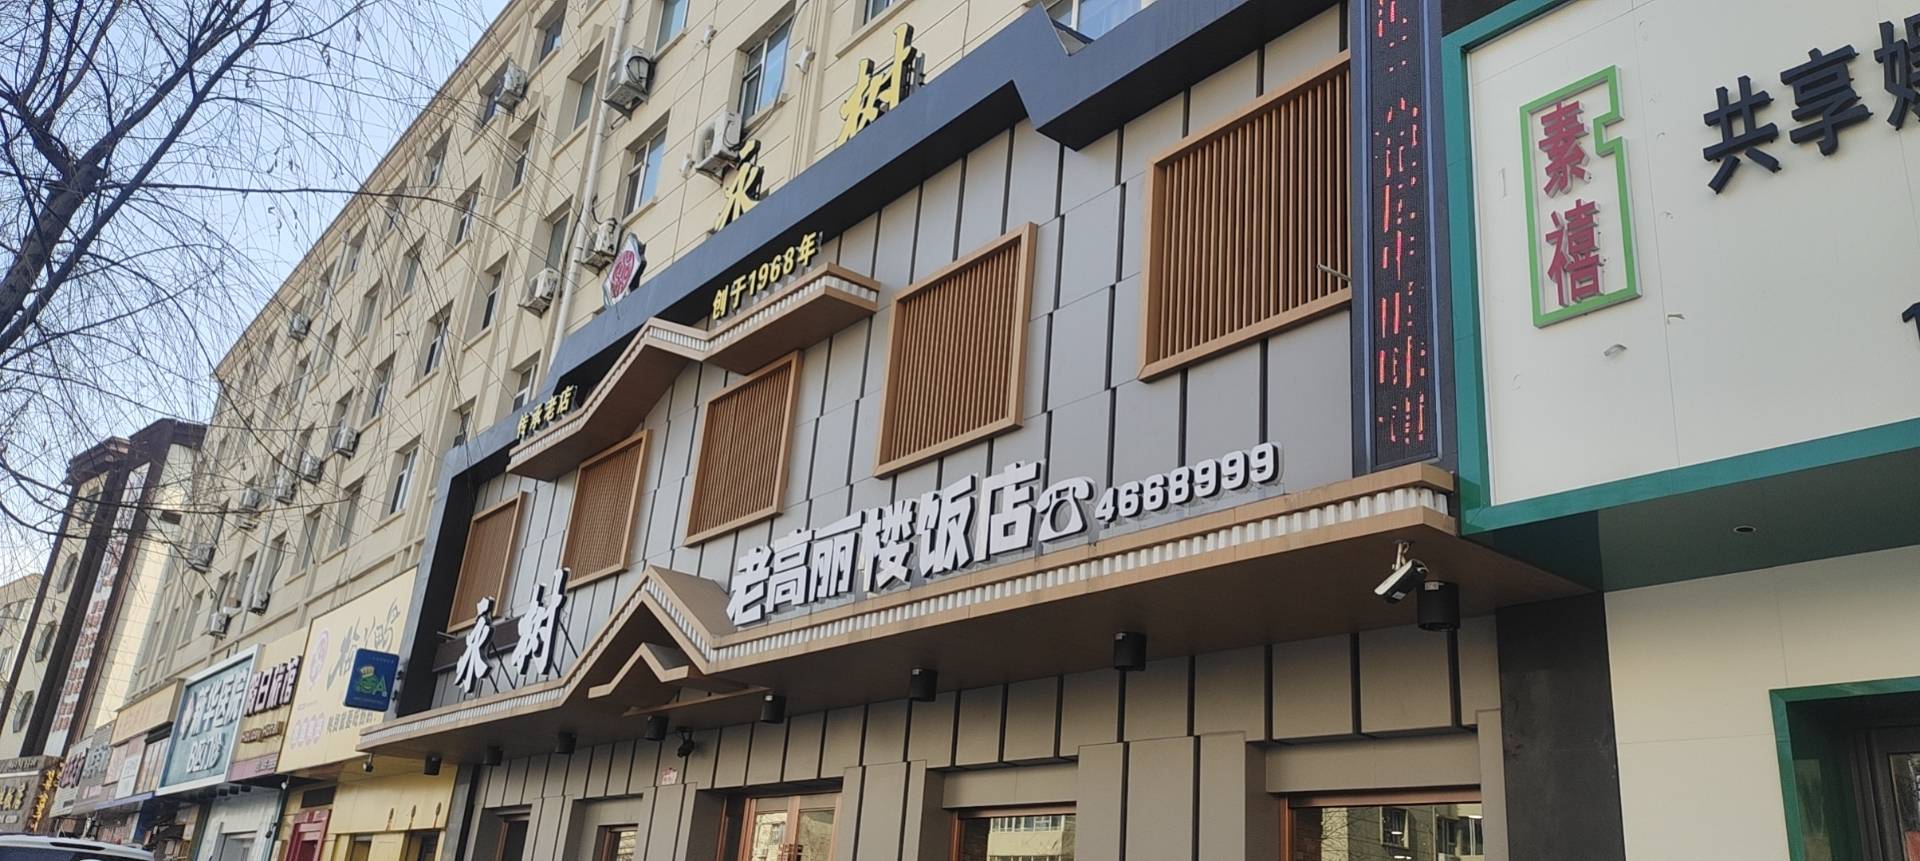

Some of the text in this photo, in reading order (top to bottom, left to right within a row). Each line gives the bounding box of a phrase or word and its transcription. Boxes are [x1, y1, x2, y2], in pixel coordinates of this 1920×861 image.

[1538, 101, 1602, 308] 素禧
[712, 232, 819, 320] 创于1968年
[516, 384, 577, 440] 传承老店
[726, 442, 1278, 627] 老高丽楼饭店 4668999
[453, 567, 571, 694] 永树
